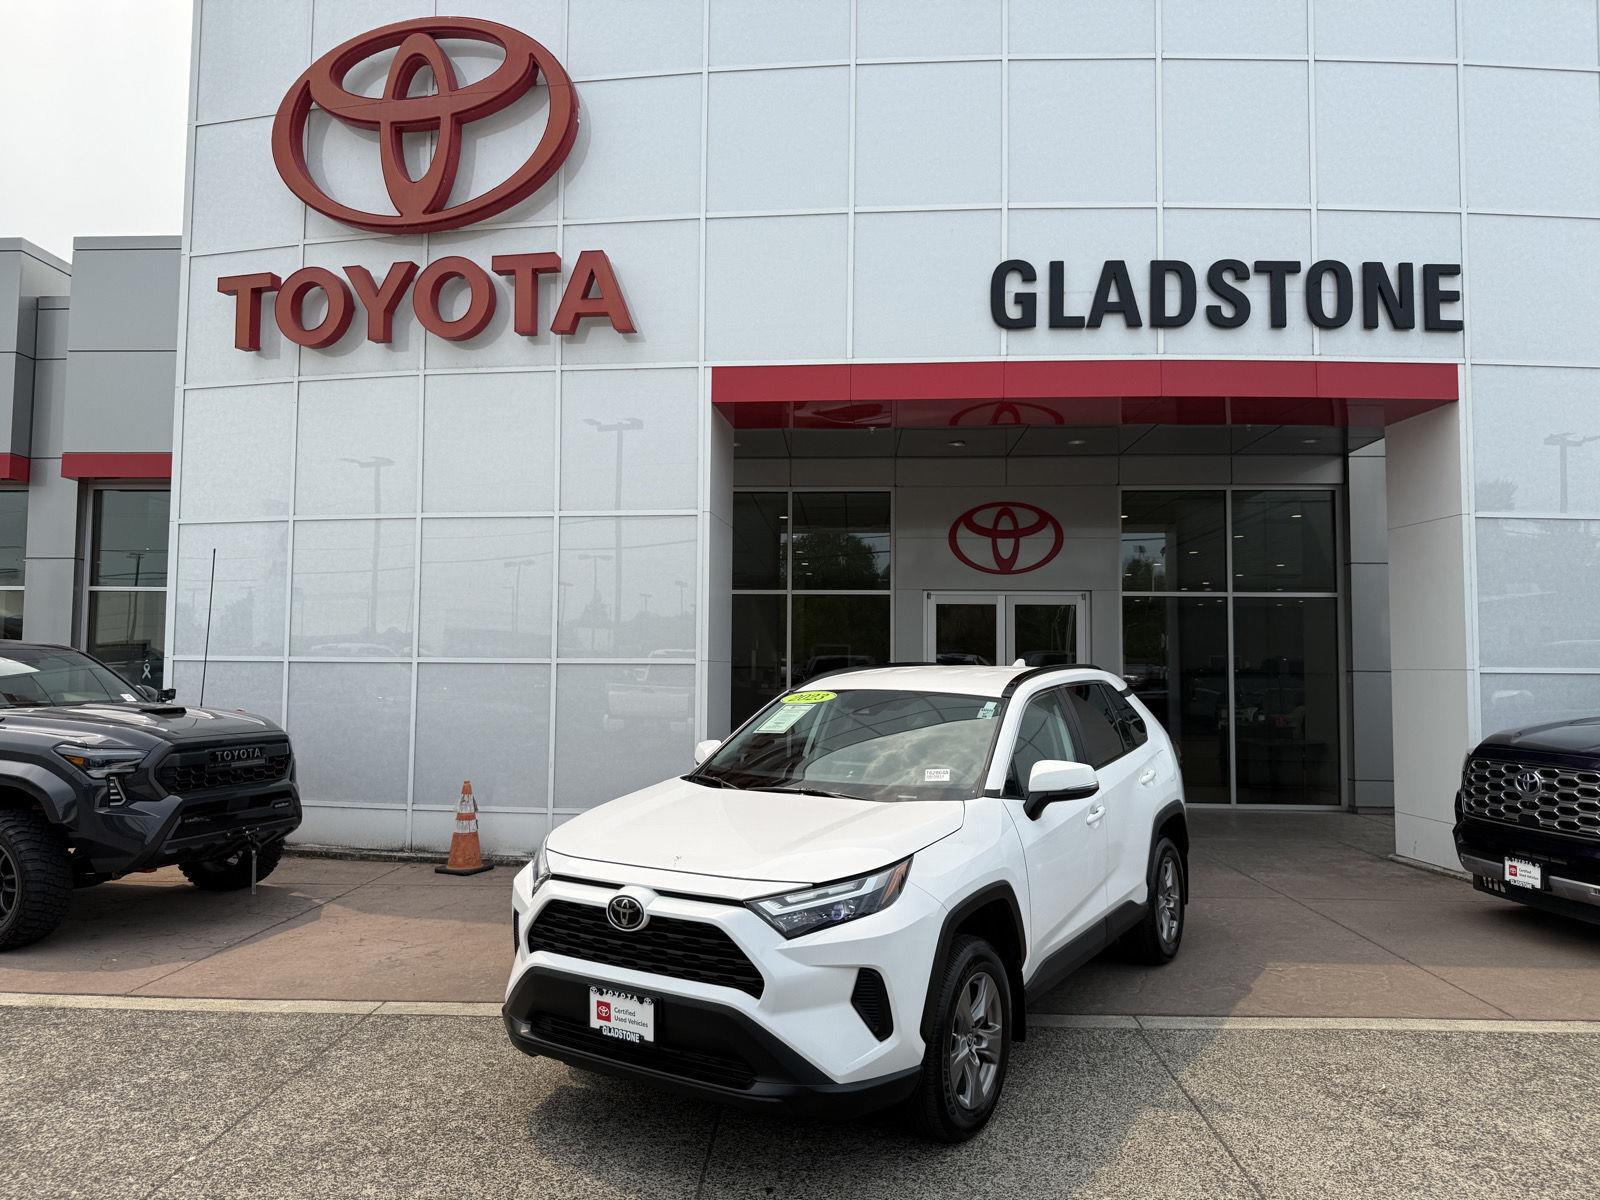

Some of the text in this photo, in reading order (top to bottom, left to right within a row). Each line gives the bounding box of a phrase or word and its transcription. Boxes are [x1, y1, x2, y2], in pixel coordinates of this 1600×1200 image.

[217, 249, 637, 352] TOYOTA
[990, 258, 1464, 331] GLADSTONE
[215, 748, 261, 761] TOYOTA
[602, 988, 639, 1002] TOYOTA
[613, 1006, 636, 1017] Certified
[614, 1015, 649, 1028] Used Vehicles
[602, 1025, 640, 1043] GLADSTONE
